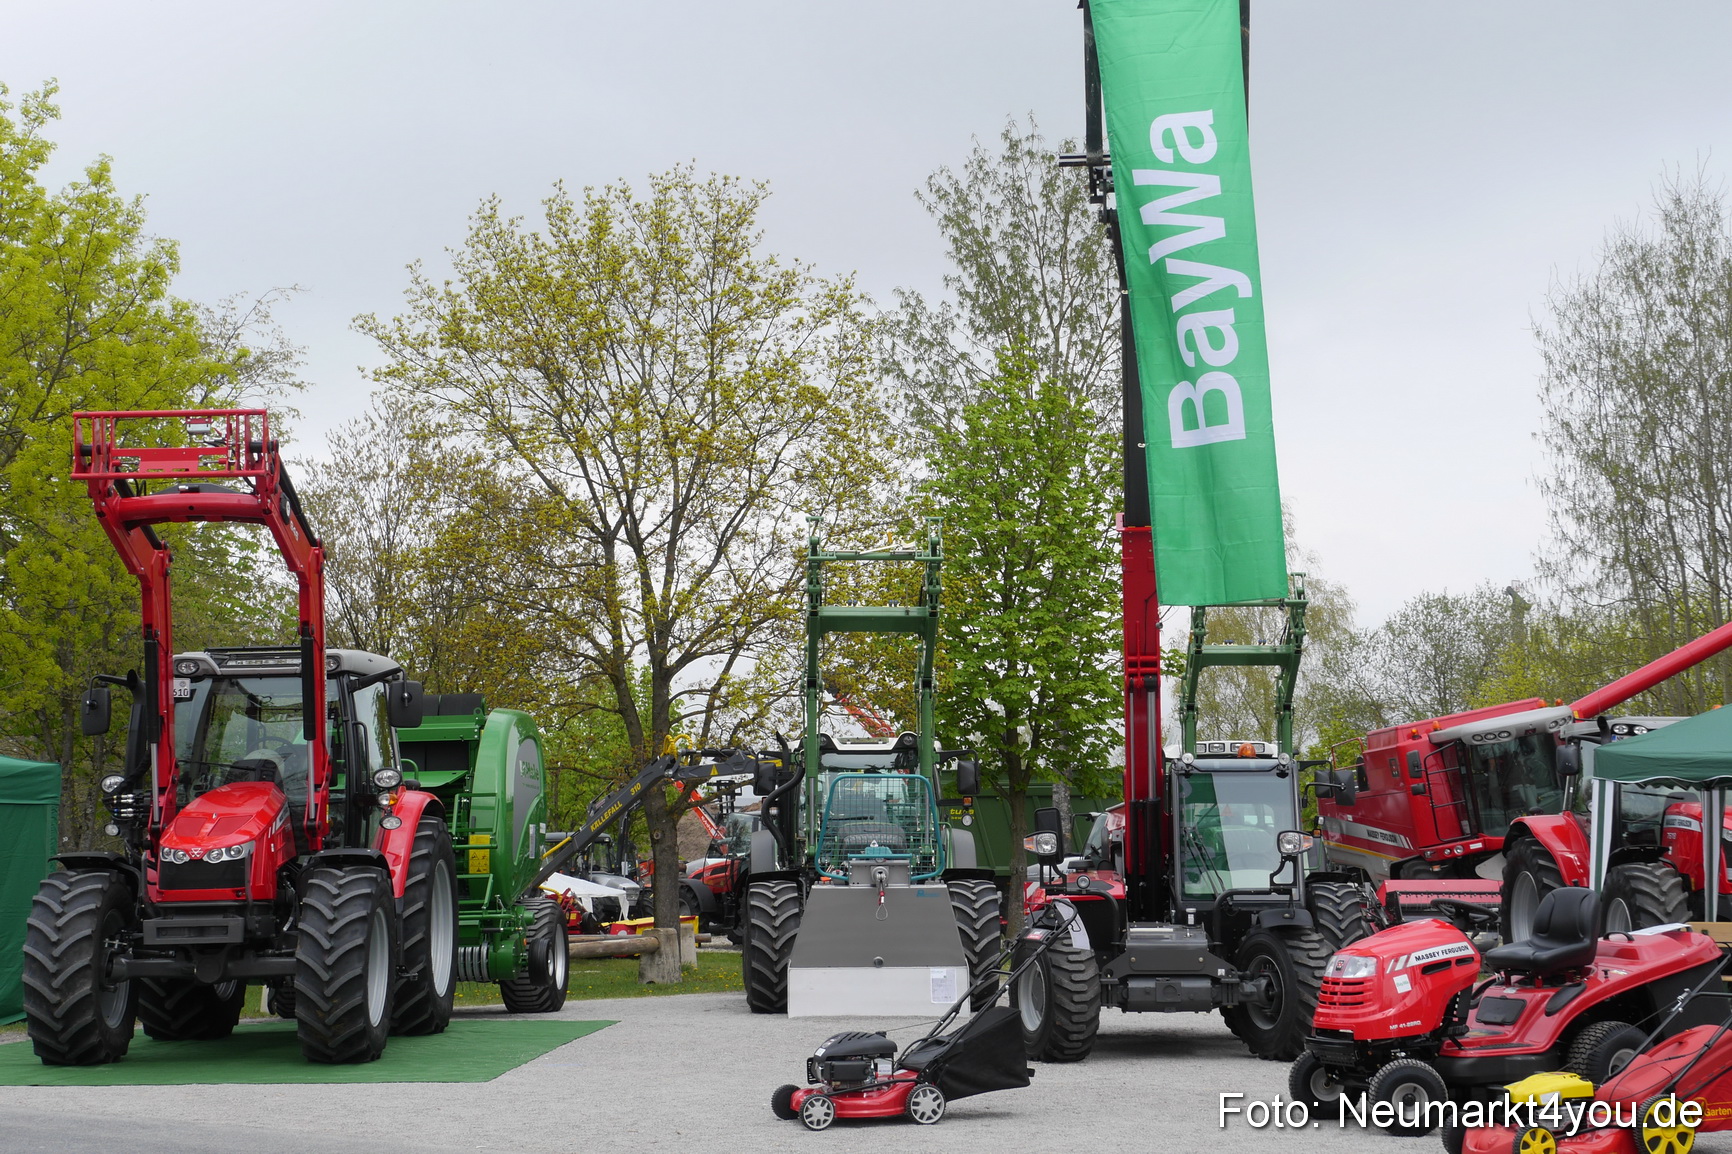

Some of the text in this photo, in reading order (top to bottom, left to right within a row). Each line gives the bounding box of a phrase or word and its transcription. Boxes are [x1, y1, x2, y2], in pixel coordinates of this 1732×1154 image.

[1132, 108, 1253, 449] BayWa
[630, 782, 641, 796] 310
[1415, 944, 1470, 962] MASSEY FERGUSON
[1704, 1107, 1732, 1117] Garten
